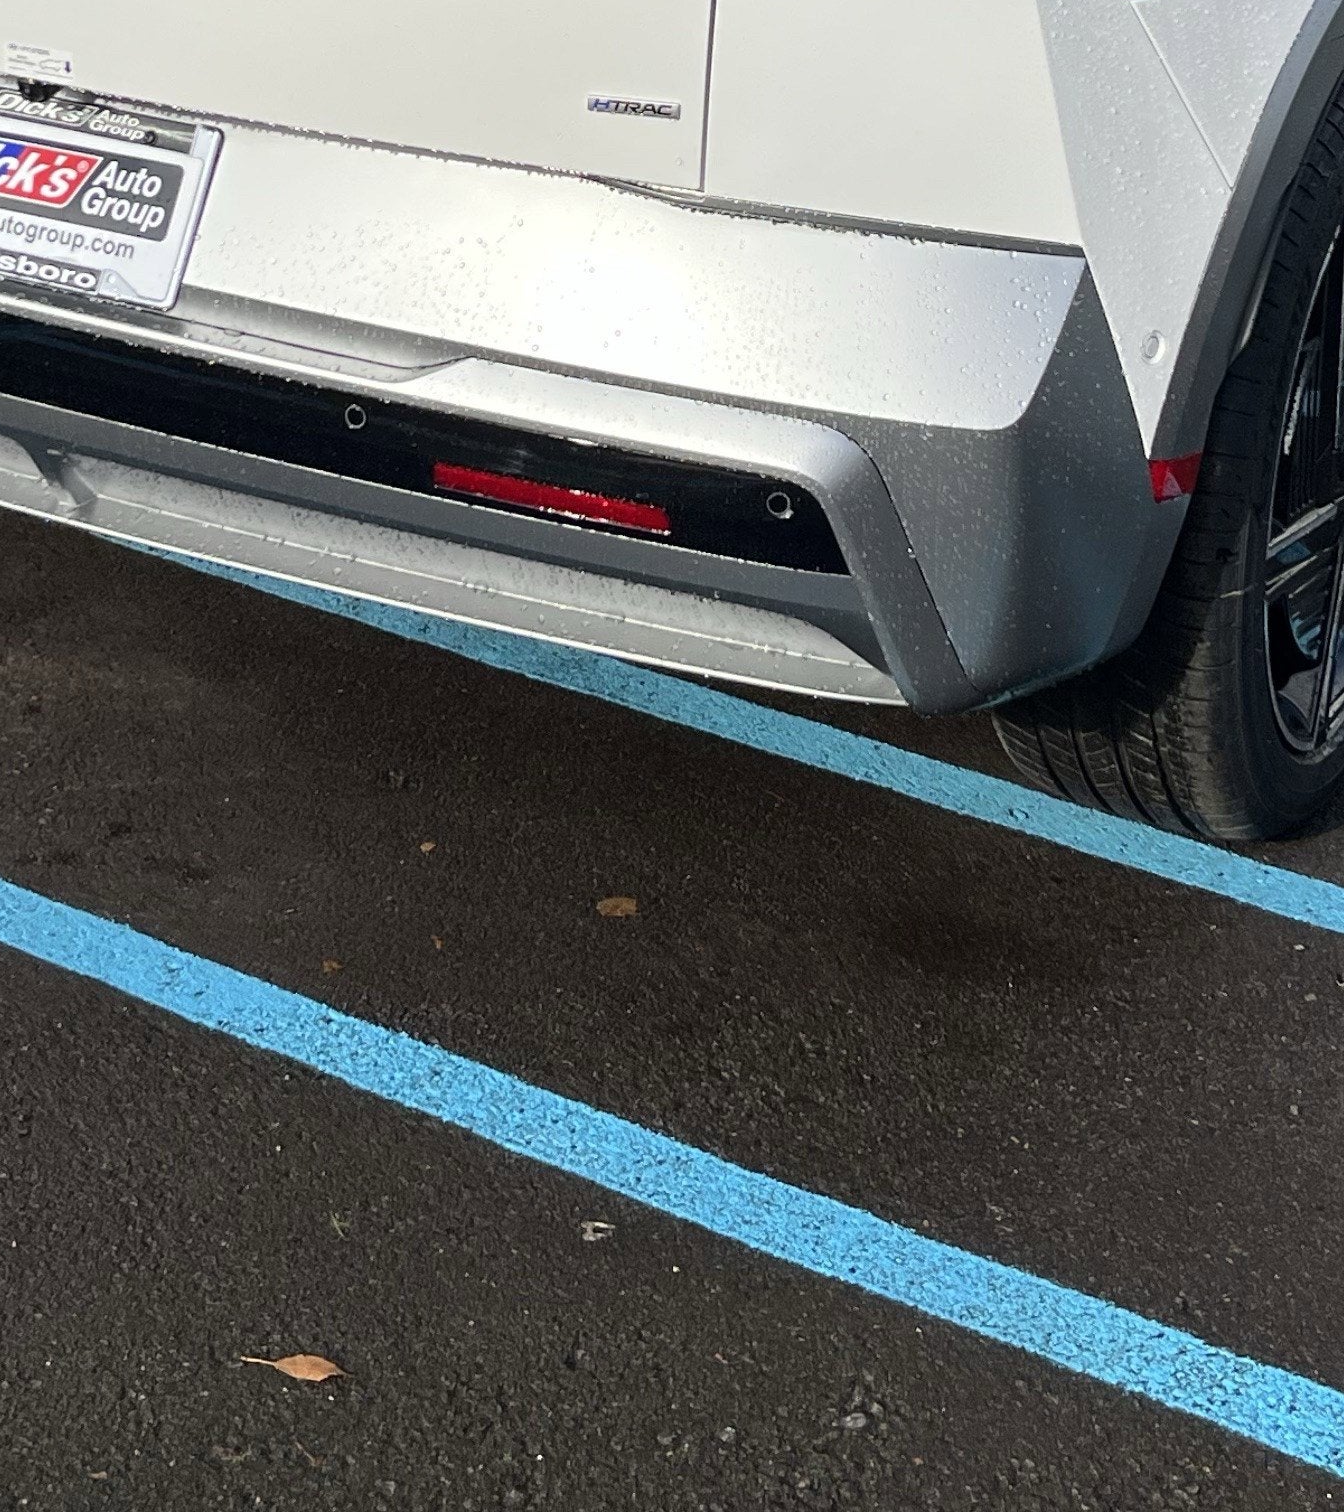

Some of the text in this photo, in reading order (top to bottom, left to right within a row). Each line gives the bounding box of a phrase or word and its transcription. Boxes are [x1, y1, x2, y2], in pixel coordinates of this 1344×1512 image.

[96, 109, 140, 127] Auto
[593, 98, 673, 116] HTRAC
[89, 119, 146, 141] Group
[92, 160, 162, 198] Auto
[81, 187, 166, 232] Group
